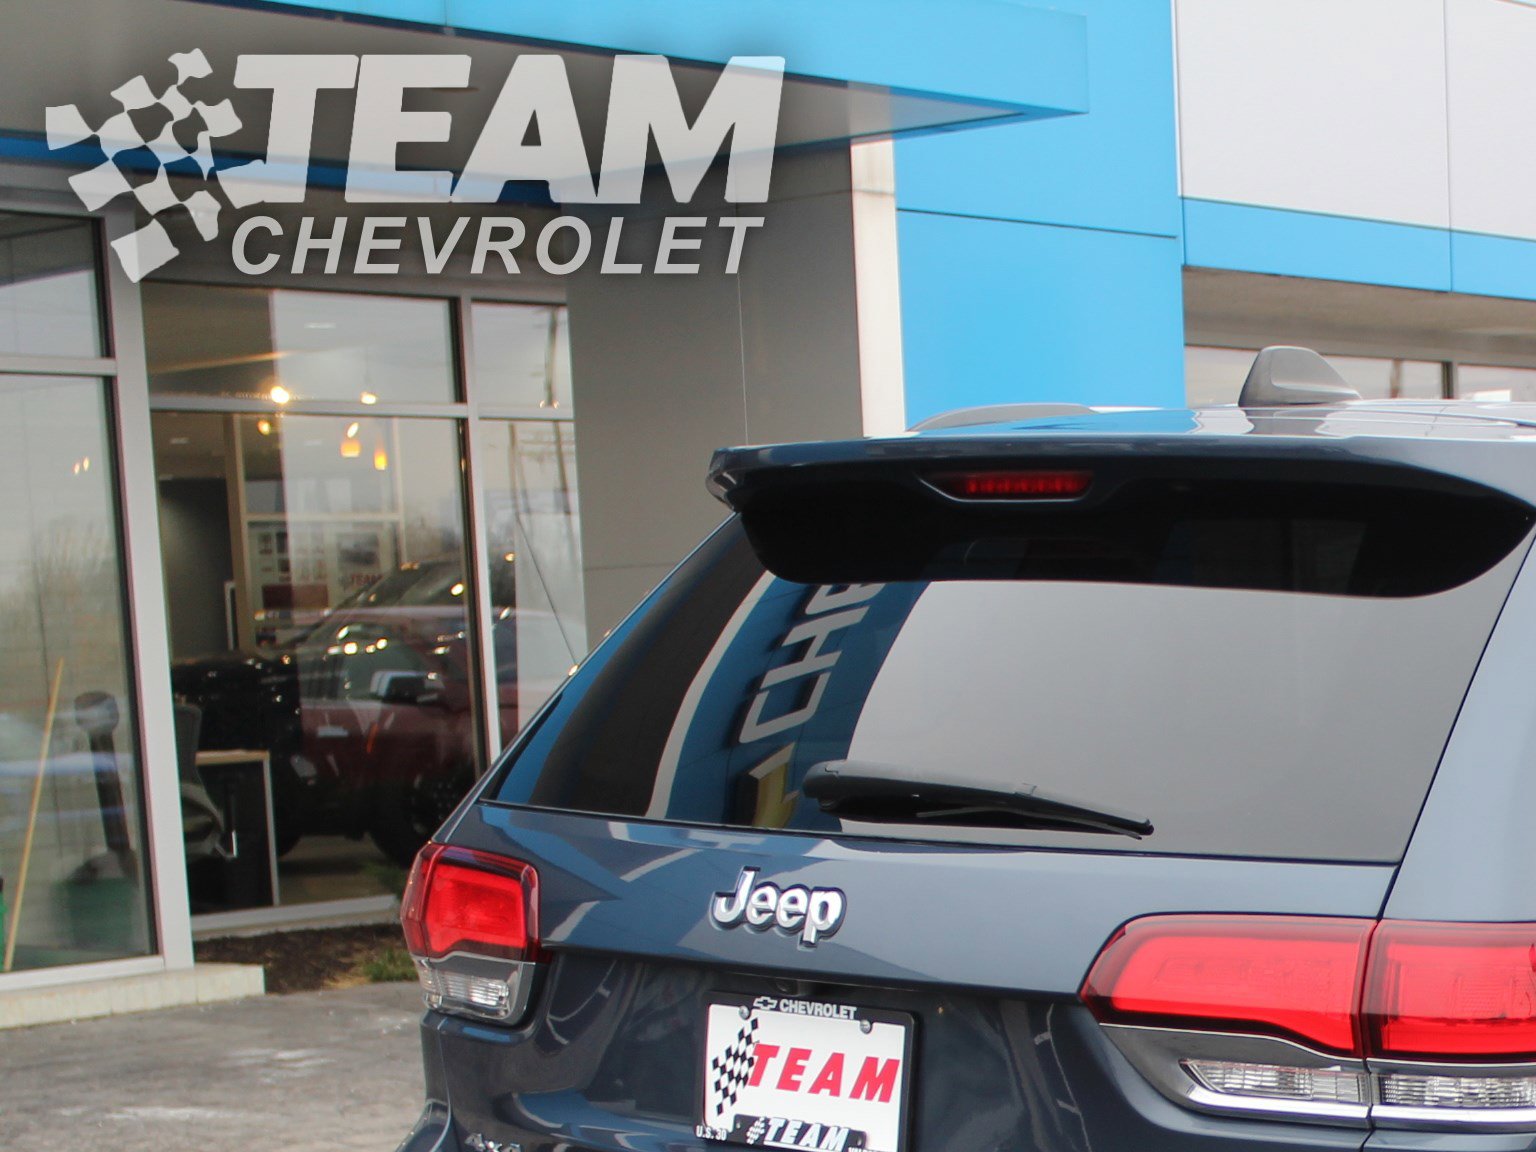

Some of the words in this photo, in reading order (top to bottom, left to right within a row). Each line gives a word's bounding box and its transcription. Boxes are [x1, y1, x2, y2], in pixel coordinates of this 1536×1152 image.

[709, 866, 848, 951] Jeep
[779, 999, 857, 1020] CHEVROLET
[748, 1043, 901, 1103] TEAM
